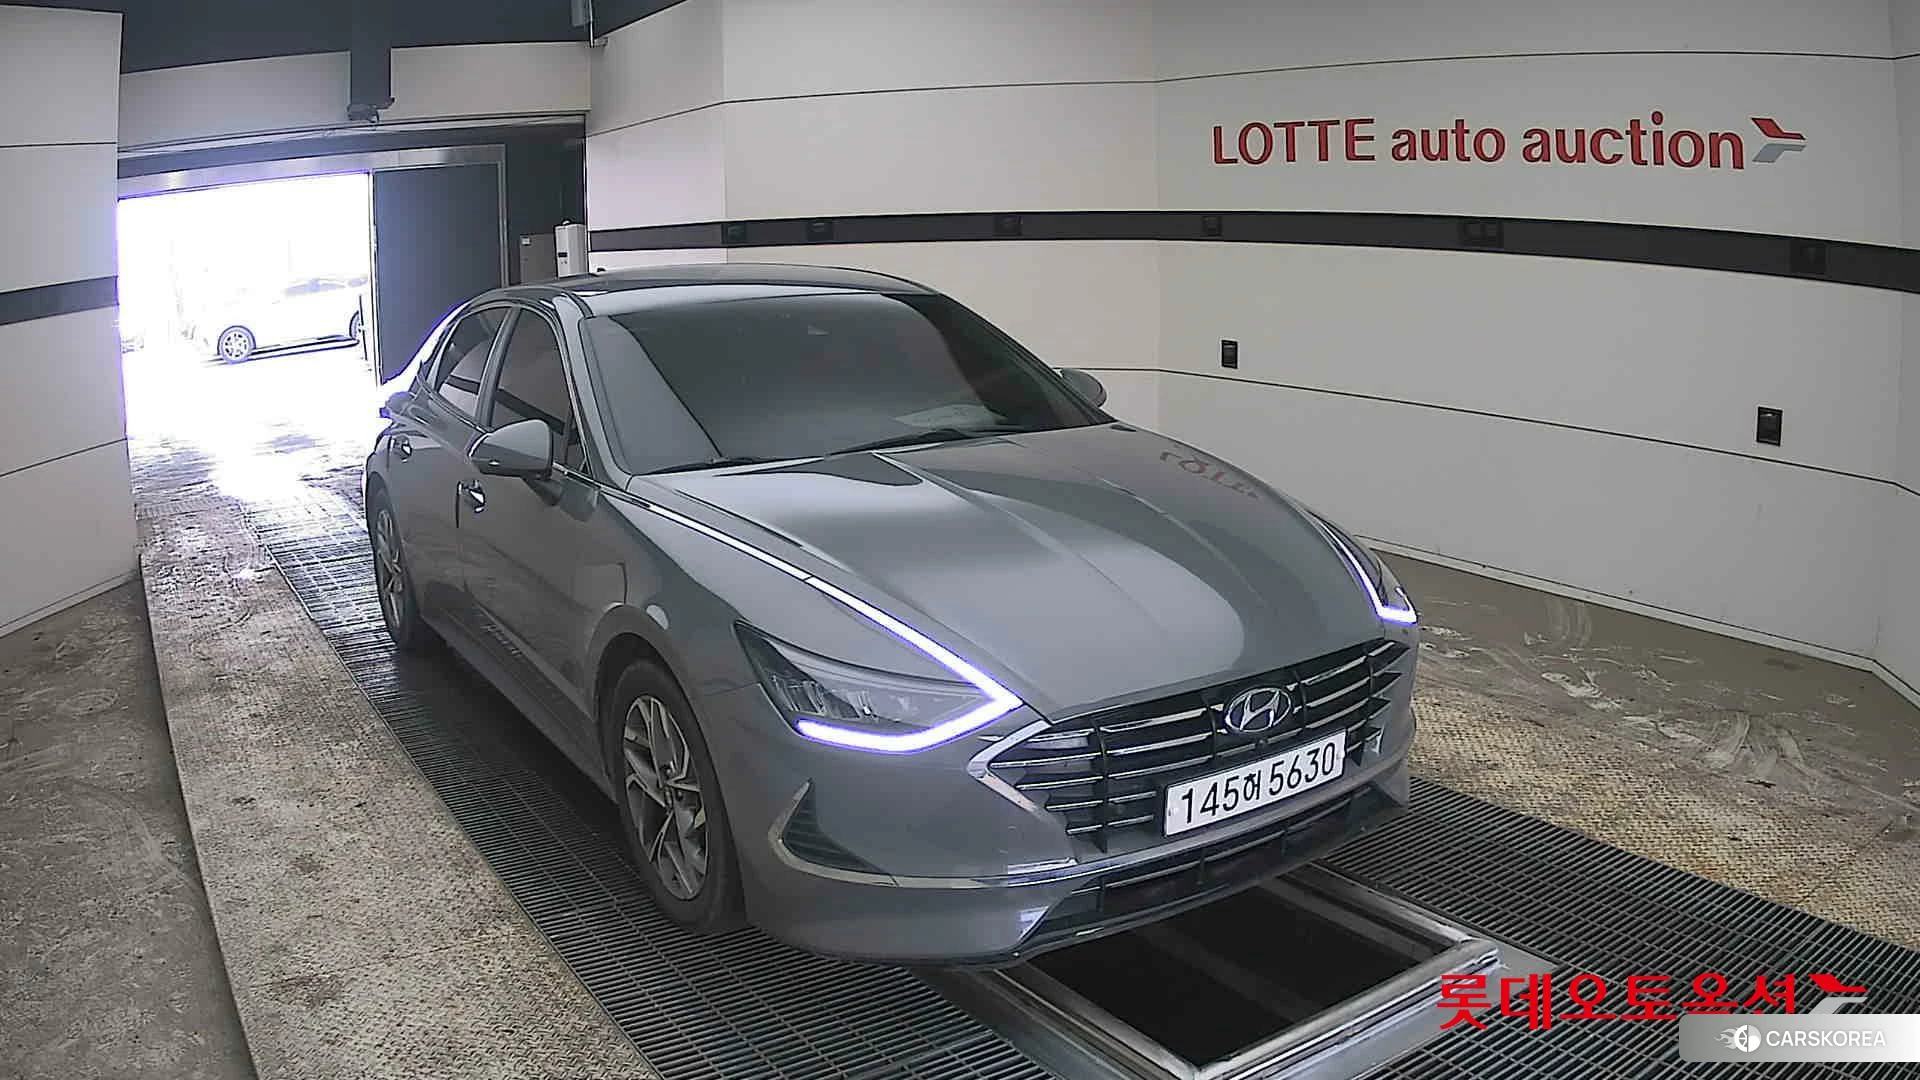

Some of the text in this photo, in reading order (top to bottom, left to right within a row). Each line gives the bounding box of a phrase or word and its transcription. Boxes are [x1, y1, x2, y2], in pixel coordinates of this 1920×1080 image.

[1212, 111, 1745, 170] LOTTE auto auction
